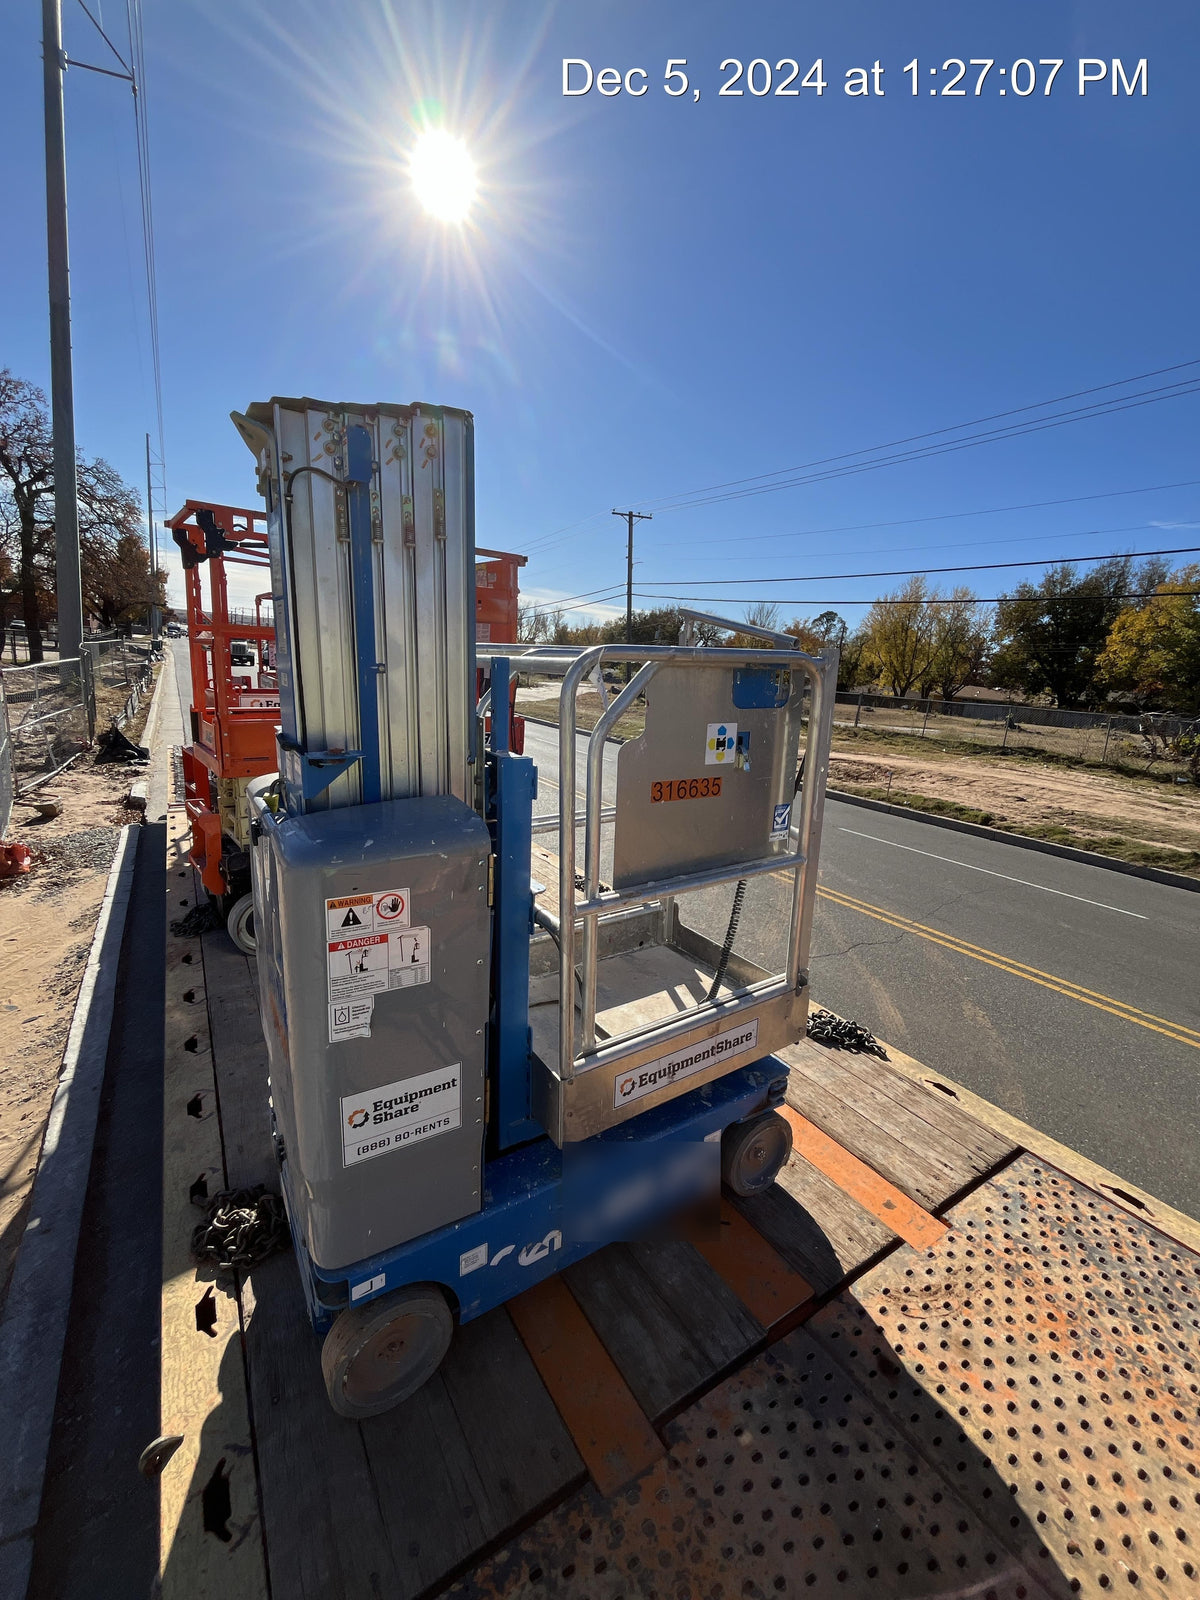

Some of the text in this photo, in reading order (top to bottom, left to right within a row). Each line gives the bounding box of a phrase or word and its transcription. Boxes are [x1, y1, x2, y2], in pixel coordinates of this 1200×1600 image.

[652, 777, 721, 802] 316635
[337, 896, 371, 907] WARNING
[346, 935, 381, 949] DANGER
[638, 1031, 753, 1088] EquipmentShare
[372, 1078, 458, 1113] Equipment
[372, 1103, 419, 1125] Share
[357, 1117, 450, 1156] (888) 80-RENTS
